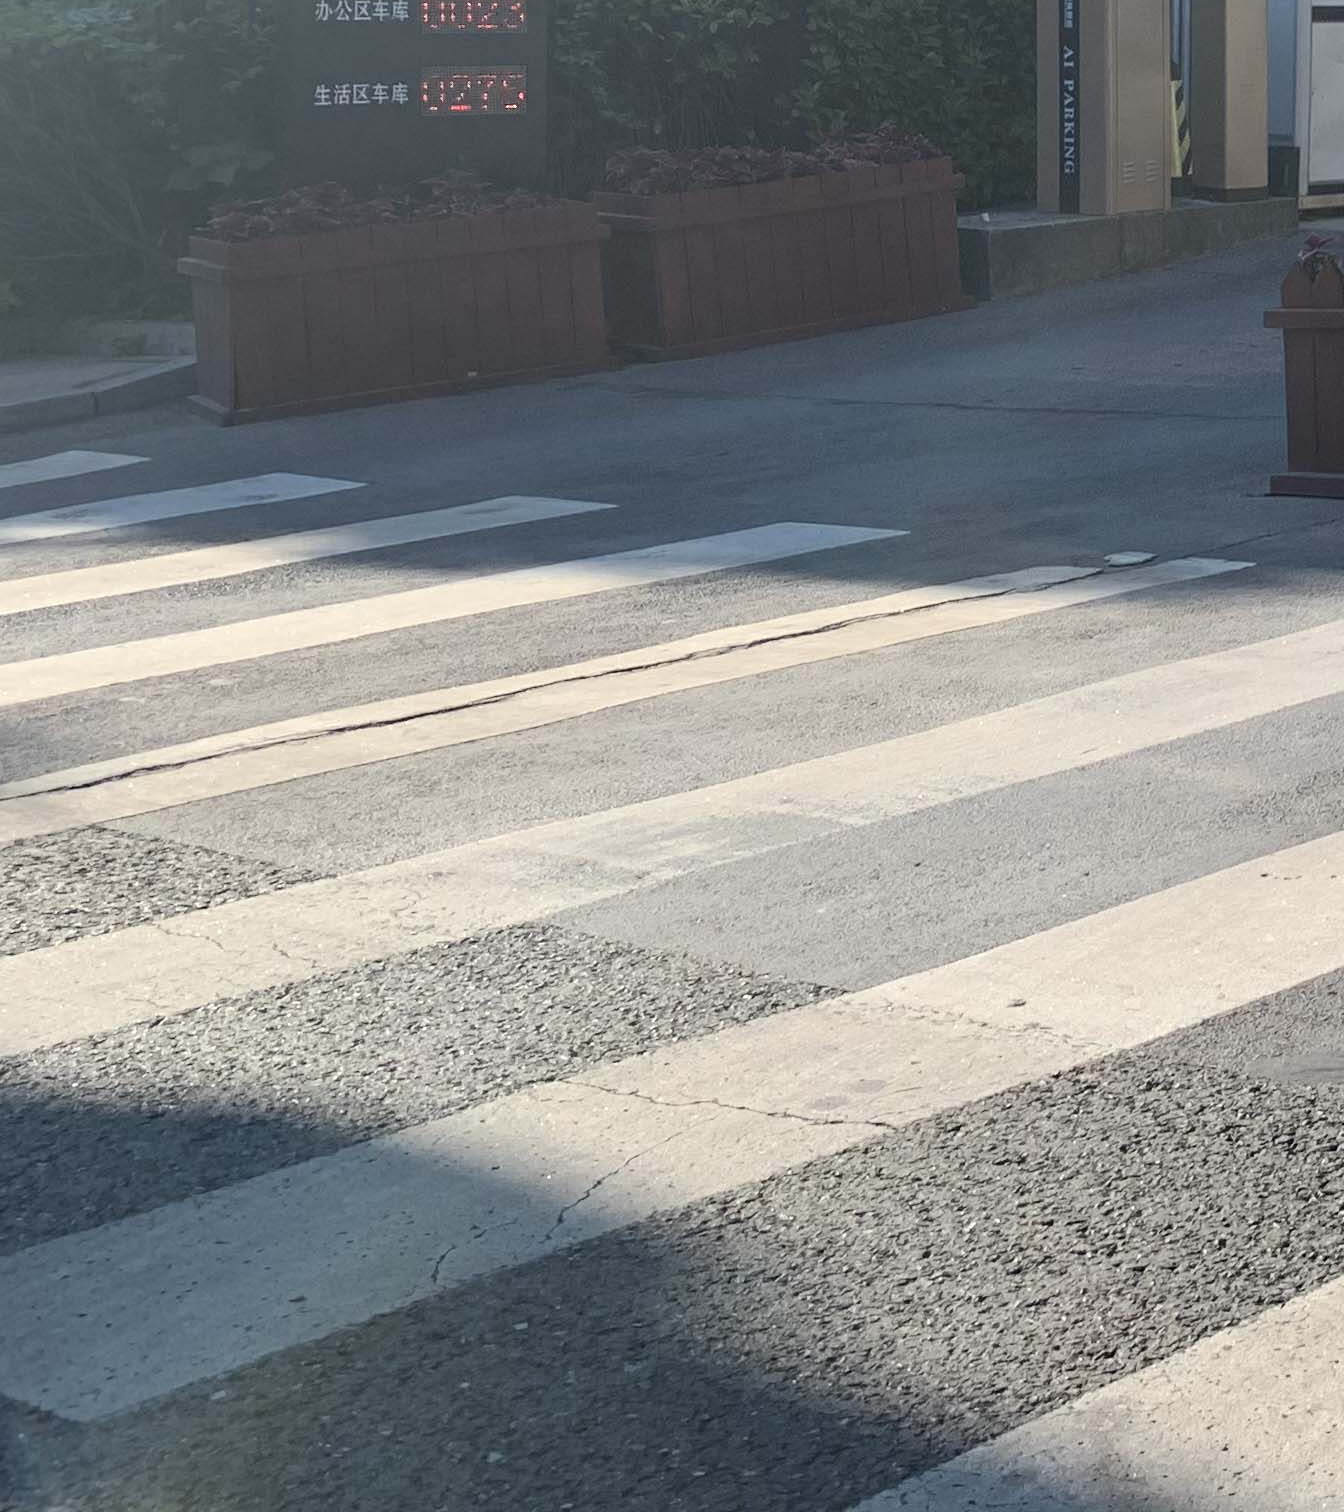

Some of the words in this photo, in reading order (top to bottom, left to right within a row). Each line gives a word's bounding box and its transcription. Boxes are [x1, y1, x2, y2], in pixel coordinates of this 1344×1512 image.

[315, 0, 409, 22] 办公区车库
[1063, 46, 1074, 67] AI
[314, 82, 409, 106] 生活区车库
[1063, 80, 1074, 174] PARKING
